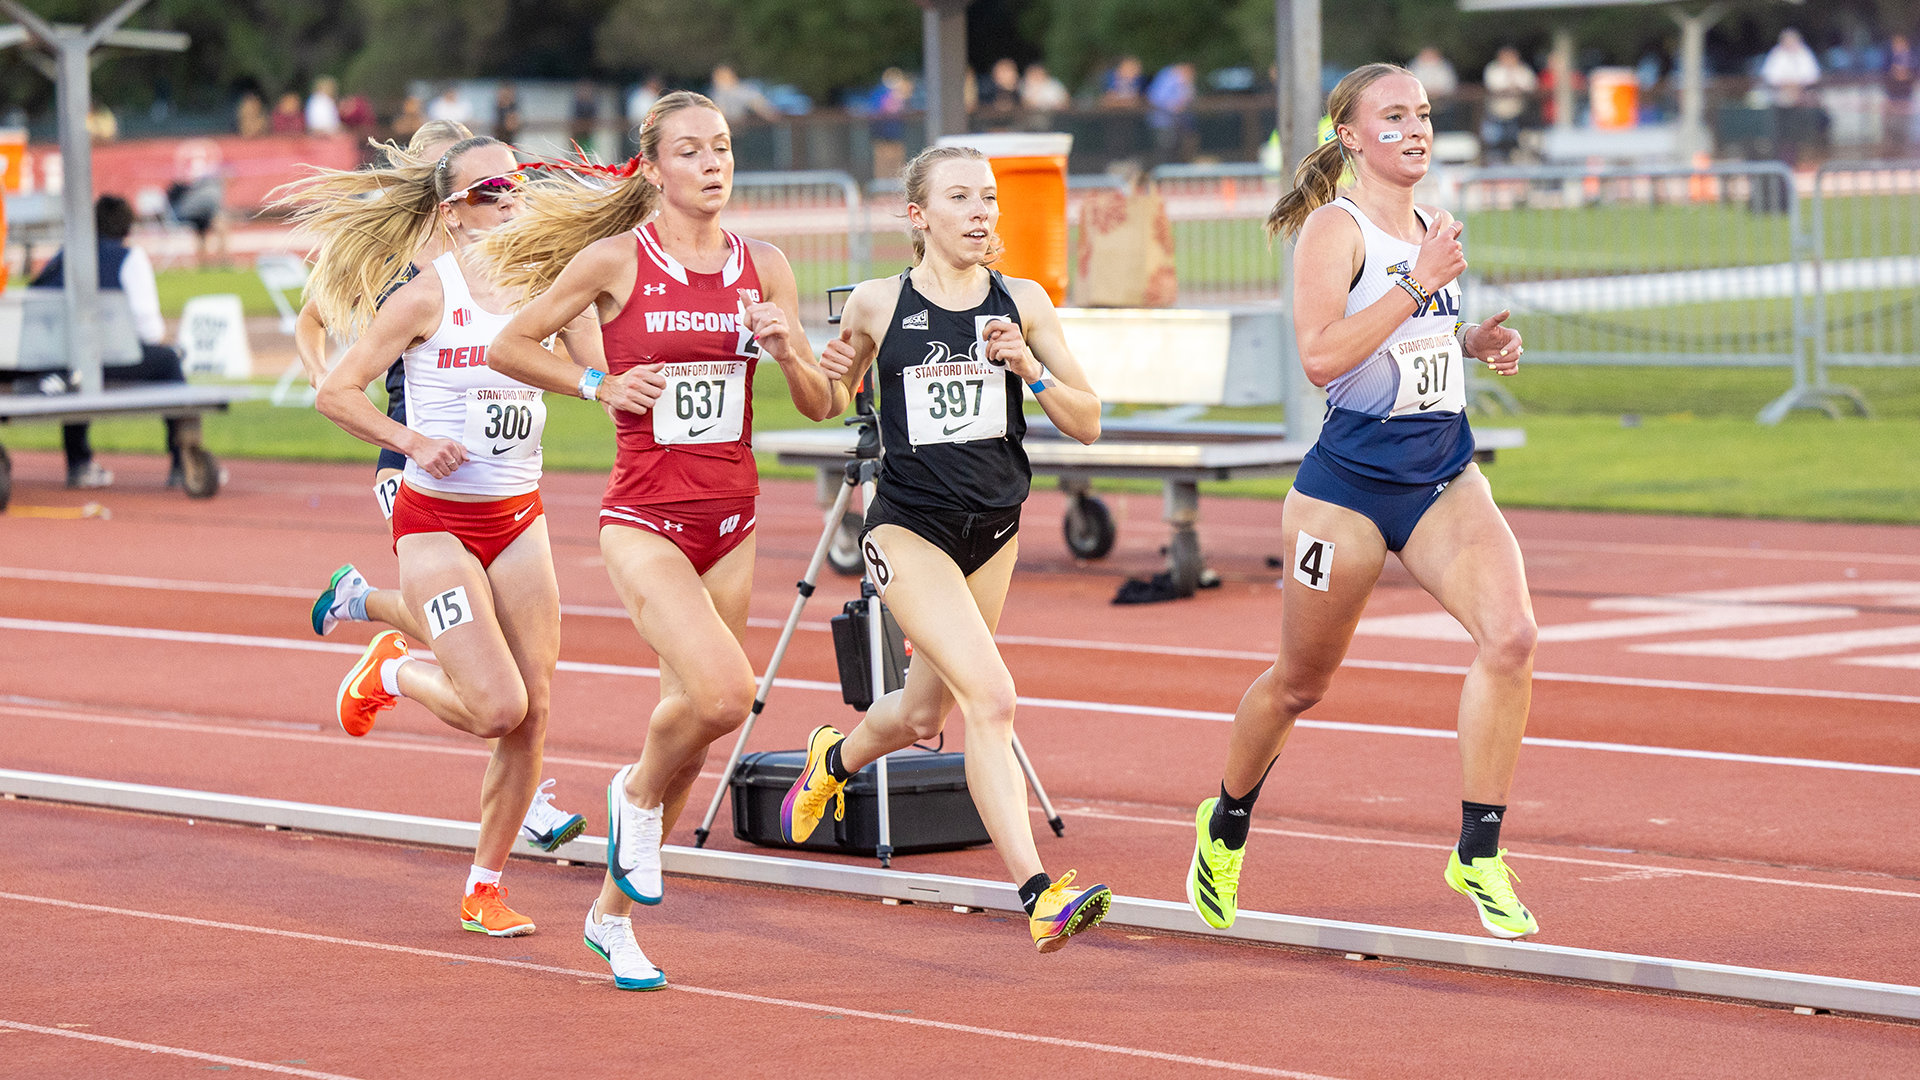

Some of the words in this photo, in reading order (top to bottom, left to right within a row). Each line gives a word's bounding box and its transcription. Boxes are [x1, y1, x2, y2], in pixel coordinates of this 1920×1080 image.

[1398, 337, 1435, 355] STANFORD
[1434, 335, 1453, 348] INVITE
[664, 364, 708, 377] STANFORD
[710, 363, 737, 376] INVITE
[915, 364, 962, 379] STANFORD
[1413, 352, 1449, 396] 317
[477, 390, 517, 401] STANFORD
[518, 391, 537, 402] INVITE
[675, 380, 726, 420] 637
[927, 380, 984, 420] 397
[485, 404, 533, 440] 300
[719, 514, 741, 537] W
[865, 541, 889, 586] 8
[1300, 541, 1324, 586] 4
[431, 591, 462, 630] 15
